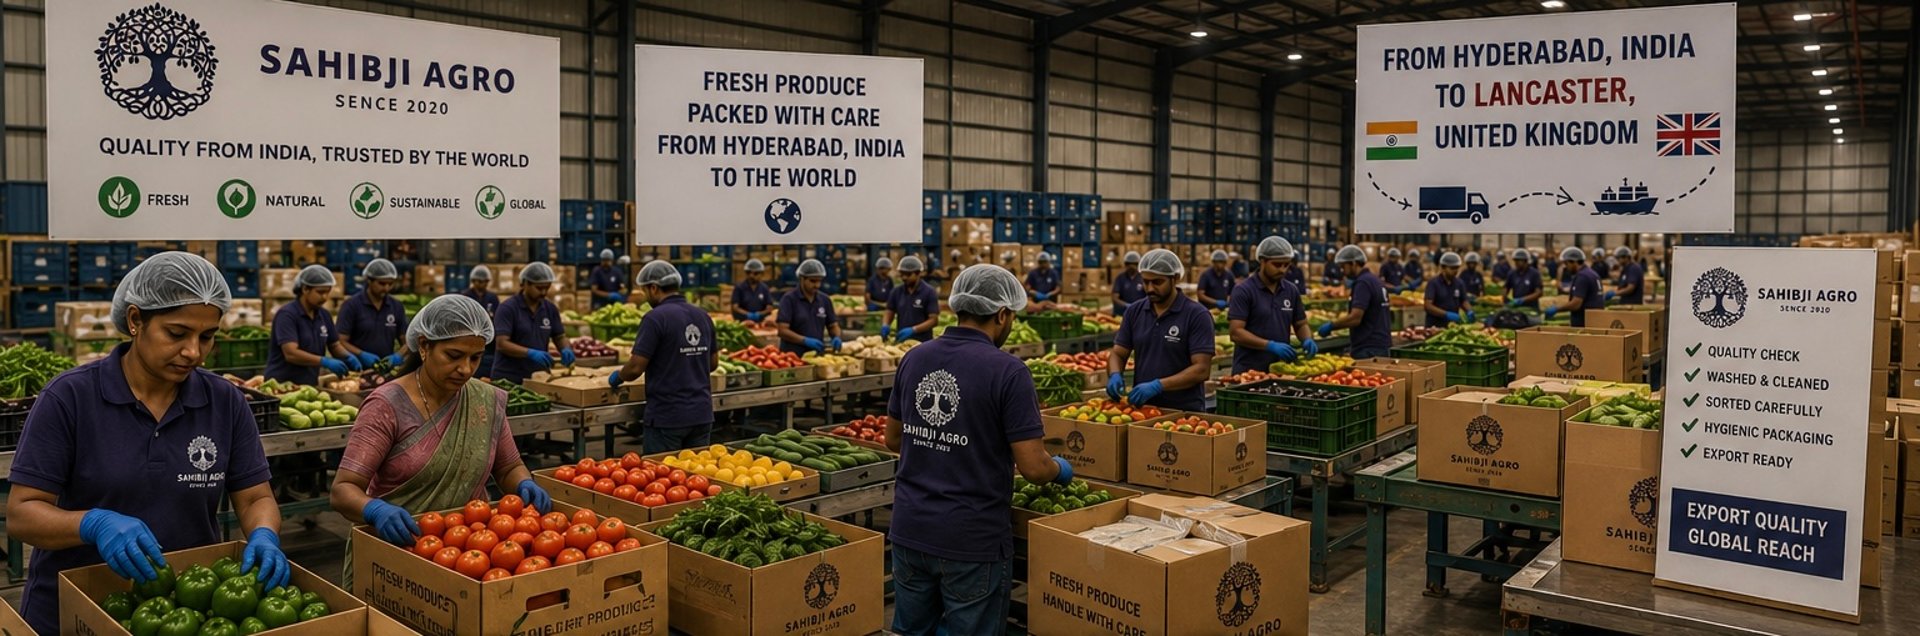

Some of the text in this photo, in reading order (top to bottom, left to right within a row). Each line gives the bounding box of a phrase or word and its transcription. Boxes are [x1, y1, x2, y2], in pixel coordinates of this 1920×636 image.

[1384, 33, 1695, 71] FROM HYDERABAD, INDIA
[260, 45, 514, 93] SAHIBJI AGRO
[704, 71, 866, 96] FRESH PRODUCE
[1435, 77, 1635, 108] TO LANCASTER,
[336, 95, 448, 114] SENCE 2020
[689, 103, 879, 126] PACKED WITH CARE
[1436, 120, 1638, 149] UNITED KINGDOM
[100, 137, 529, 167] QUALITY FROM INDIA, TRUSTED BY THE WORLD
[659, 135, 905, 160] FROM HYDERABAD, INDIA
[711, 168, 856, 187] TO THE WORLD
[148, 194, 188, 206] FRESH
[266, 195, 325, 207] NATURAL
[390, 197, 460, 208] SUSTAINABLE
[510, 199, 546, 209] GLOBAL
[1758, 288, 1857, 302] SAHIBJI AGRO
[1708, 346, 1799, 362] QUALITY CHECK
[1707, 371, 1829, 390] WASHED & CLEANED
[1706, 396, 1822, 417] SORTED CAREFULLY
[939, 431, 968, 446] AGRO
[1705, 422, 1833, 445] HYGIENIC PACKAGING
[1704, 448, 1793, 468] EXPORT READY
[1688, 502, 1827, 537] EXPORT QUALITY
[1606, 526, 1653, 545] SAHIBJ
[1689, 528, 1814, 563] GLOBAL REACH
[1049, 571, 1140, 617] FRESH PRODUCE
[828, 603, 856, 619] AGRO
[1043, 592, 1083, 619] HANDLE
[1086, 608, 1113, 631] WITH
[1249, 618, 1281, 636] AGRO
